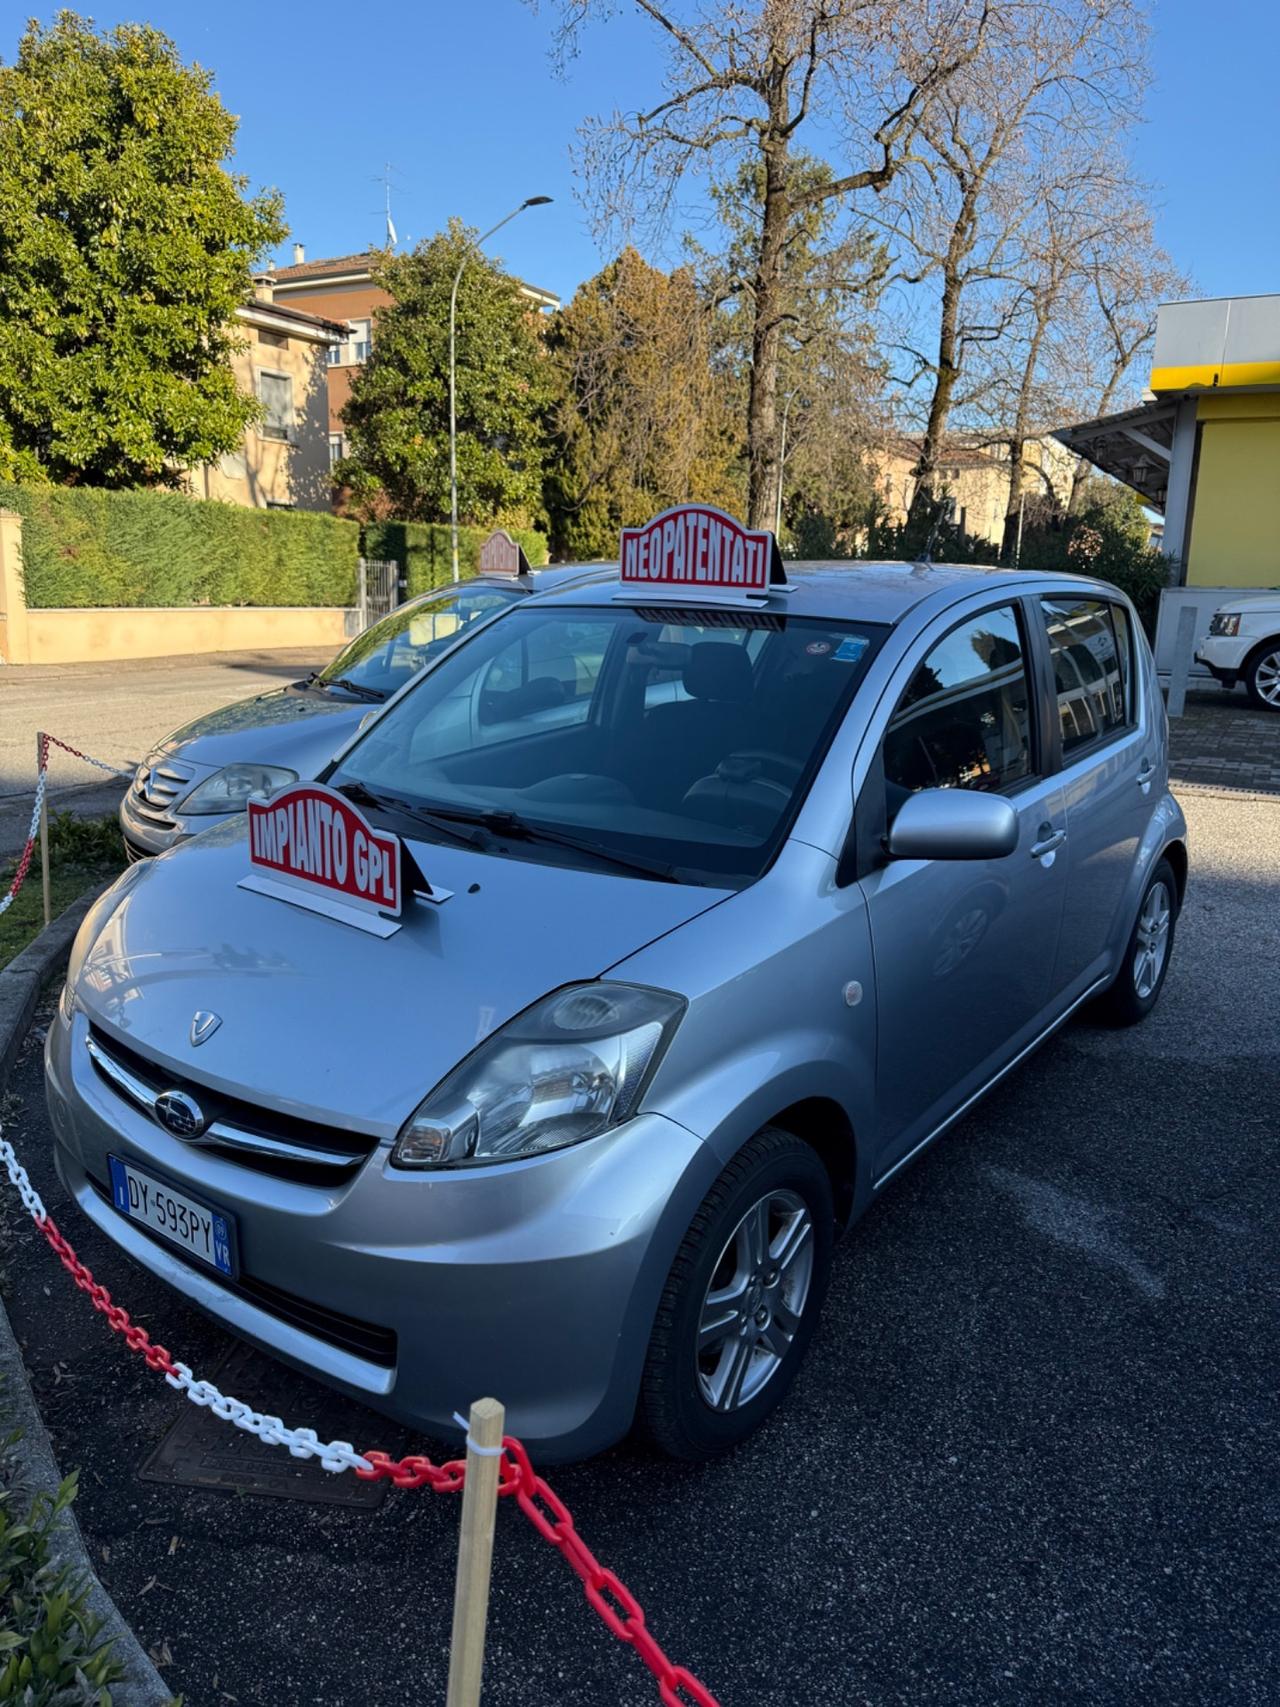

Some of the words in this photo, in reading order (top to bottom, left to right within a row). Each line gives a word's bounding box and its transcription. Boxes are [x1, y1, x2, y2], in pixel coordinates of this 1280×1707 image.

[625, 512, 764, 584] NEOPATENTATI
[252, 798, 348, 885] IMPIANTO
[353, 829, 395, 901] GPL
[128, 1175, 148, 1215] DY
[156, 1191, 211, 1253] 593PY
[215, 1241, 230, 1267] VR
